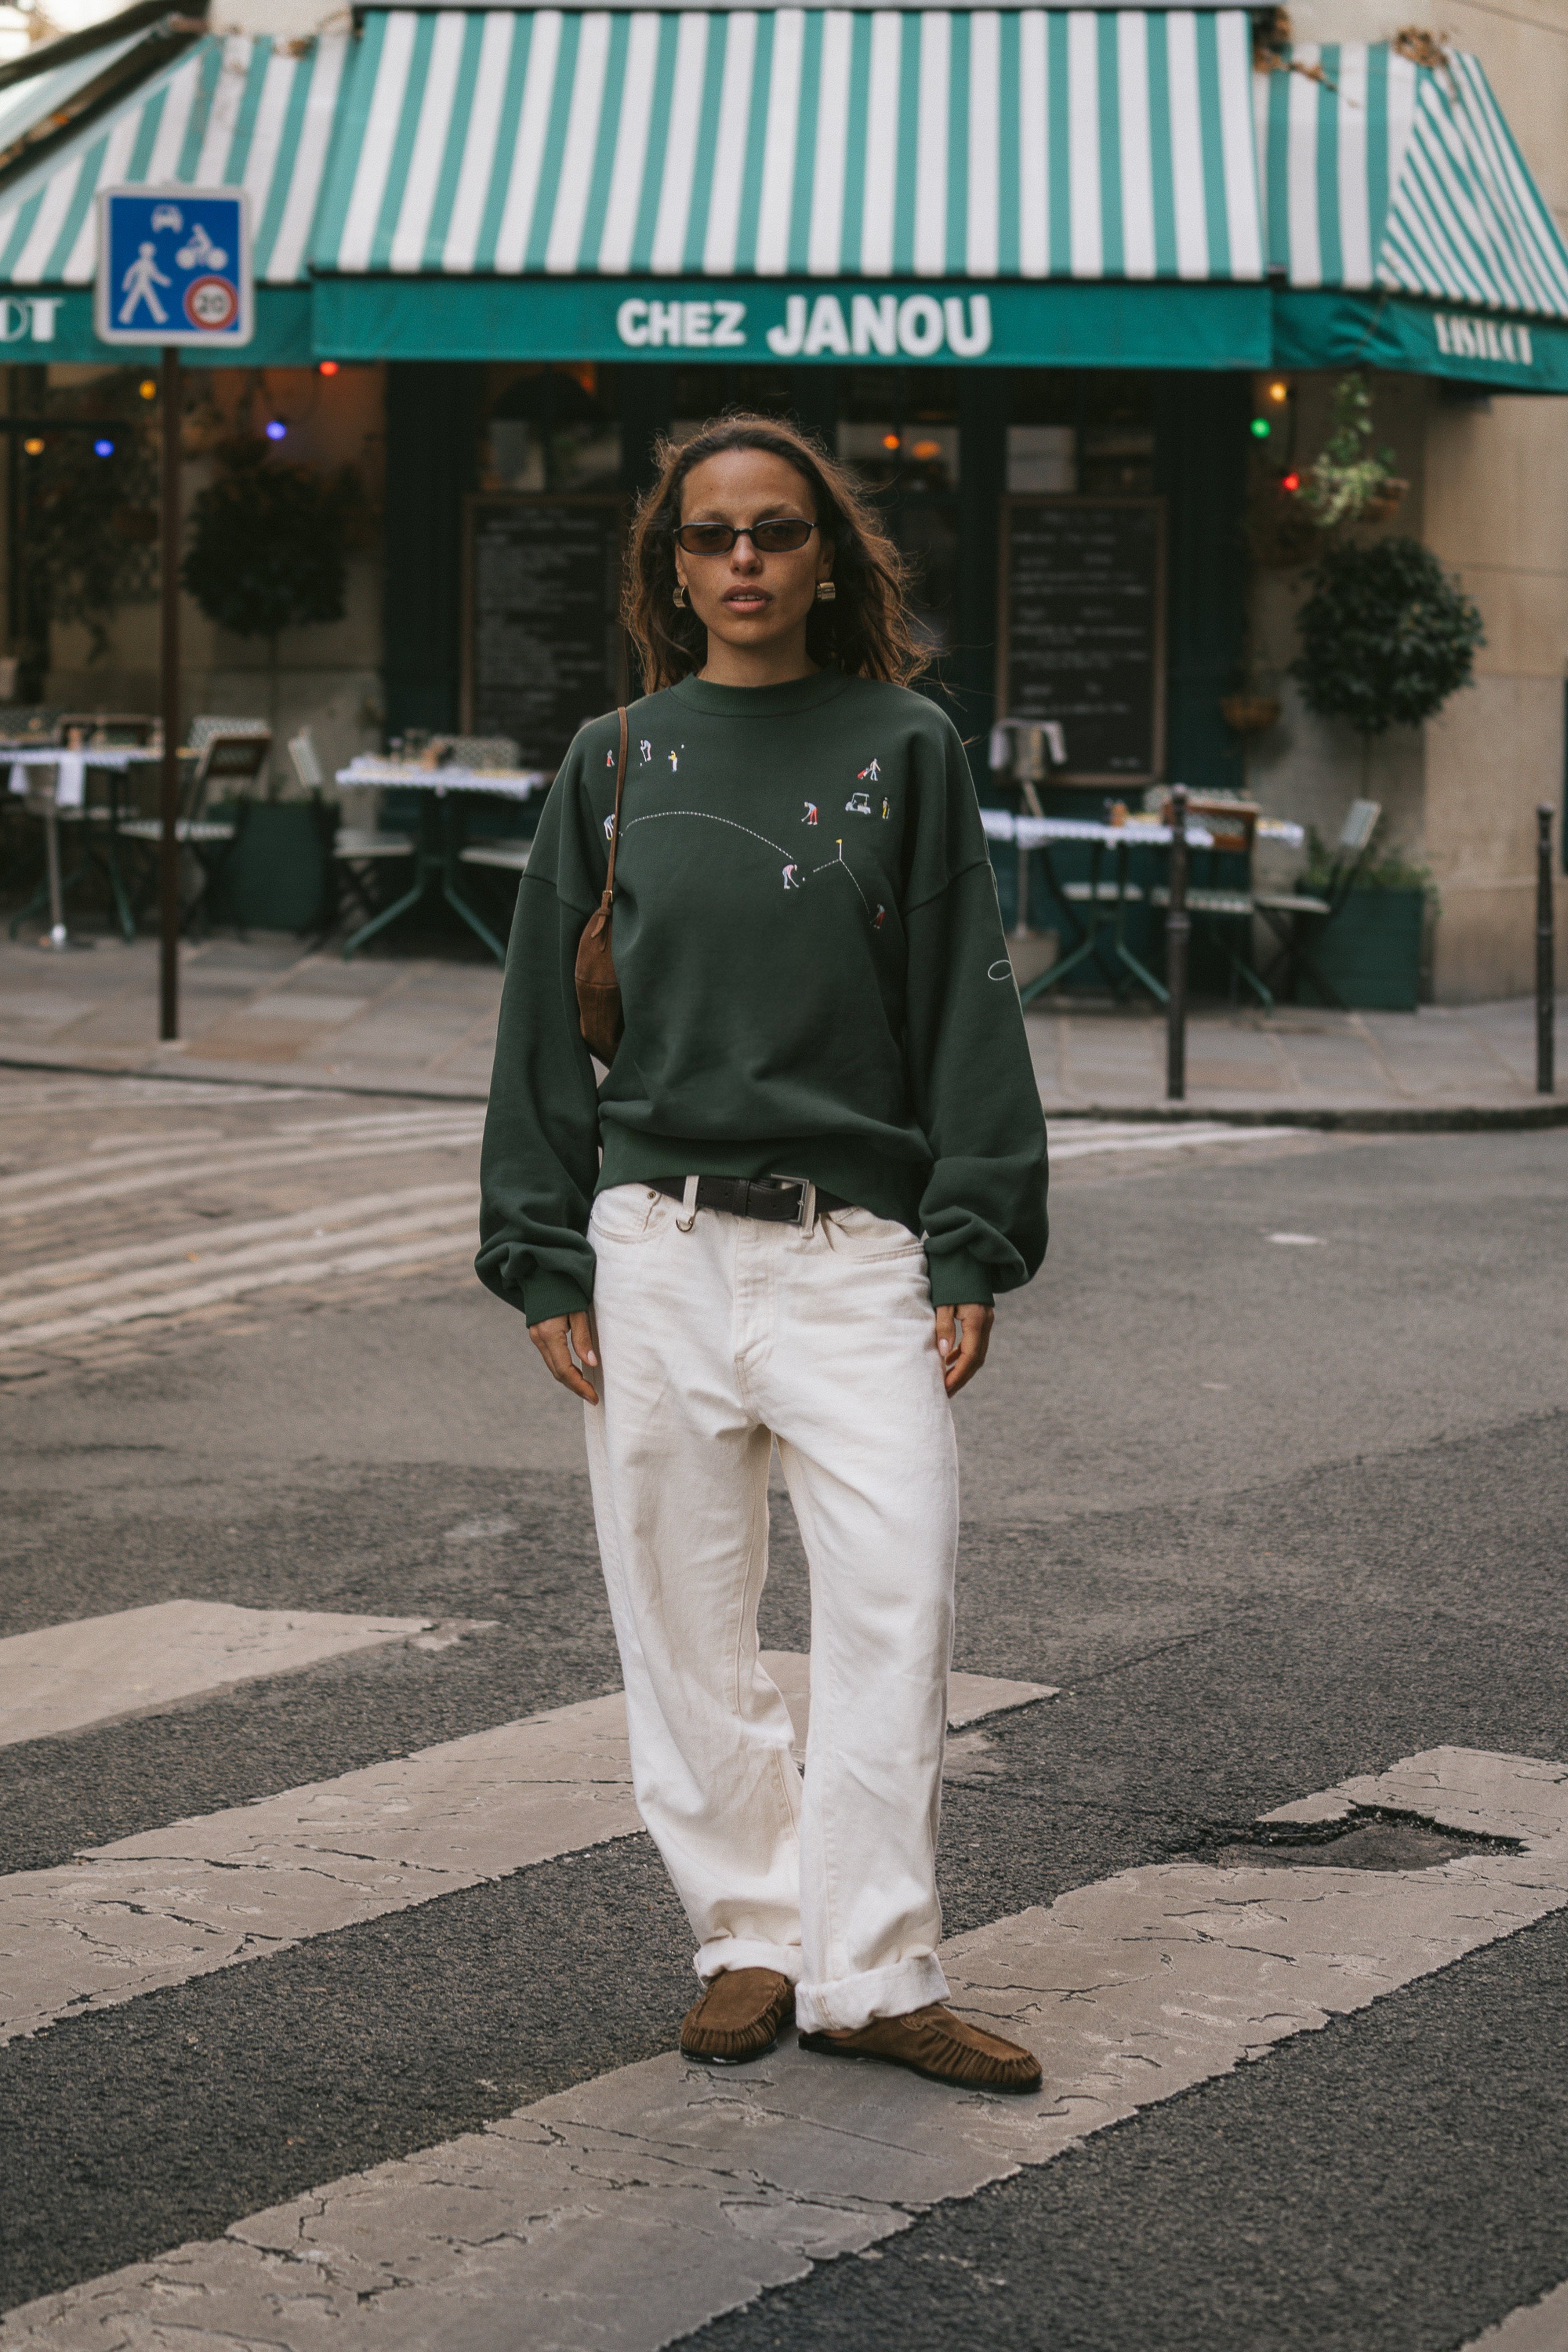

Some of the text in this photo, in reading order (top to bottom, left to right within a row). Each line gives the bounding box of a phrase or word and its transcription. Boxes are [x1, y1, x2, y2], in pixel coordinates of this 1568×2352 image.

[198, 293, 226, 313] 20
[617, 294, 992, 357] CHEZ JANOU
